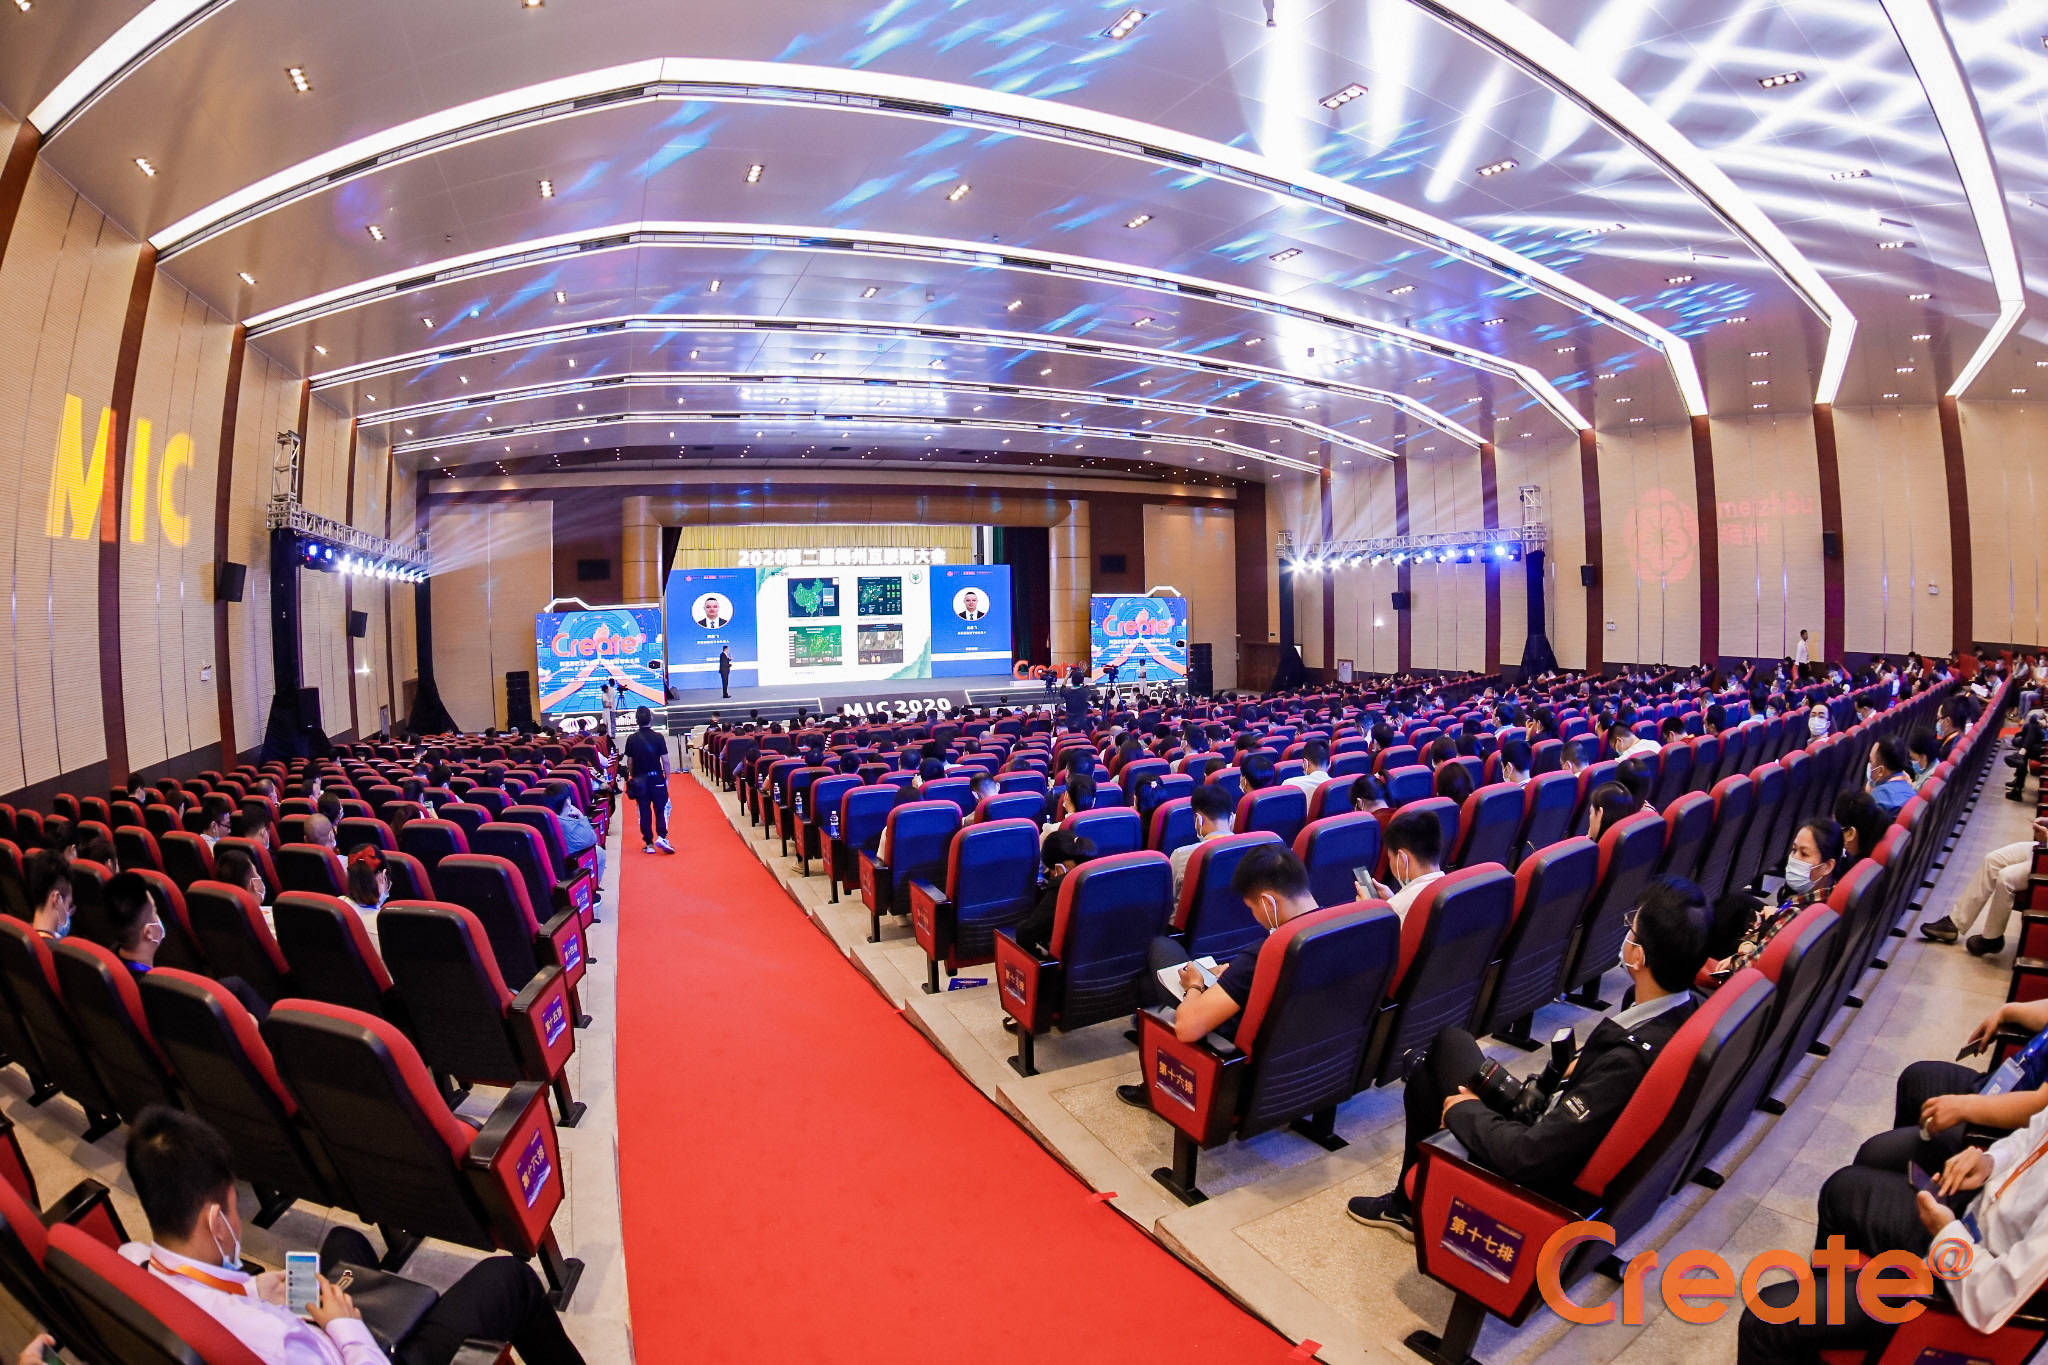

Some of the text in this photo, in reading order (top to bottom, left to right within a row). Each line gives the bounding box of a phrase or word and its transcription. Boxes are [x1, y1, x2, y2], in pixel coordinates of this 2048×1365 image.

[45, 392, 195, 547] MIC
[843, 698, 952, 717] MIC 2020
[1159, 1061, 1193, 1094] 第十六排
[1450, 1216, 1515, 1262] 第十七排
